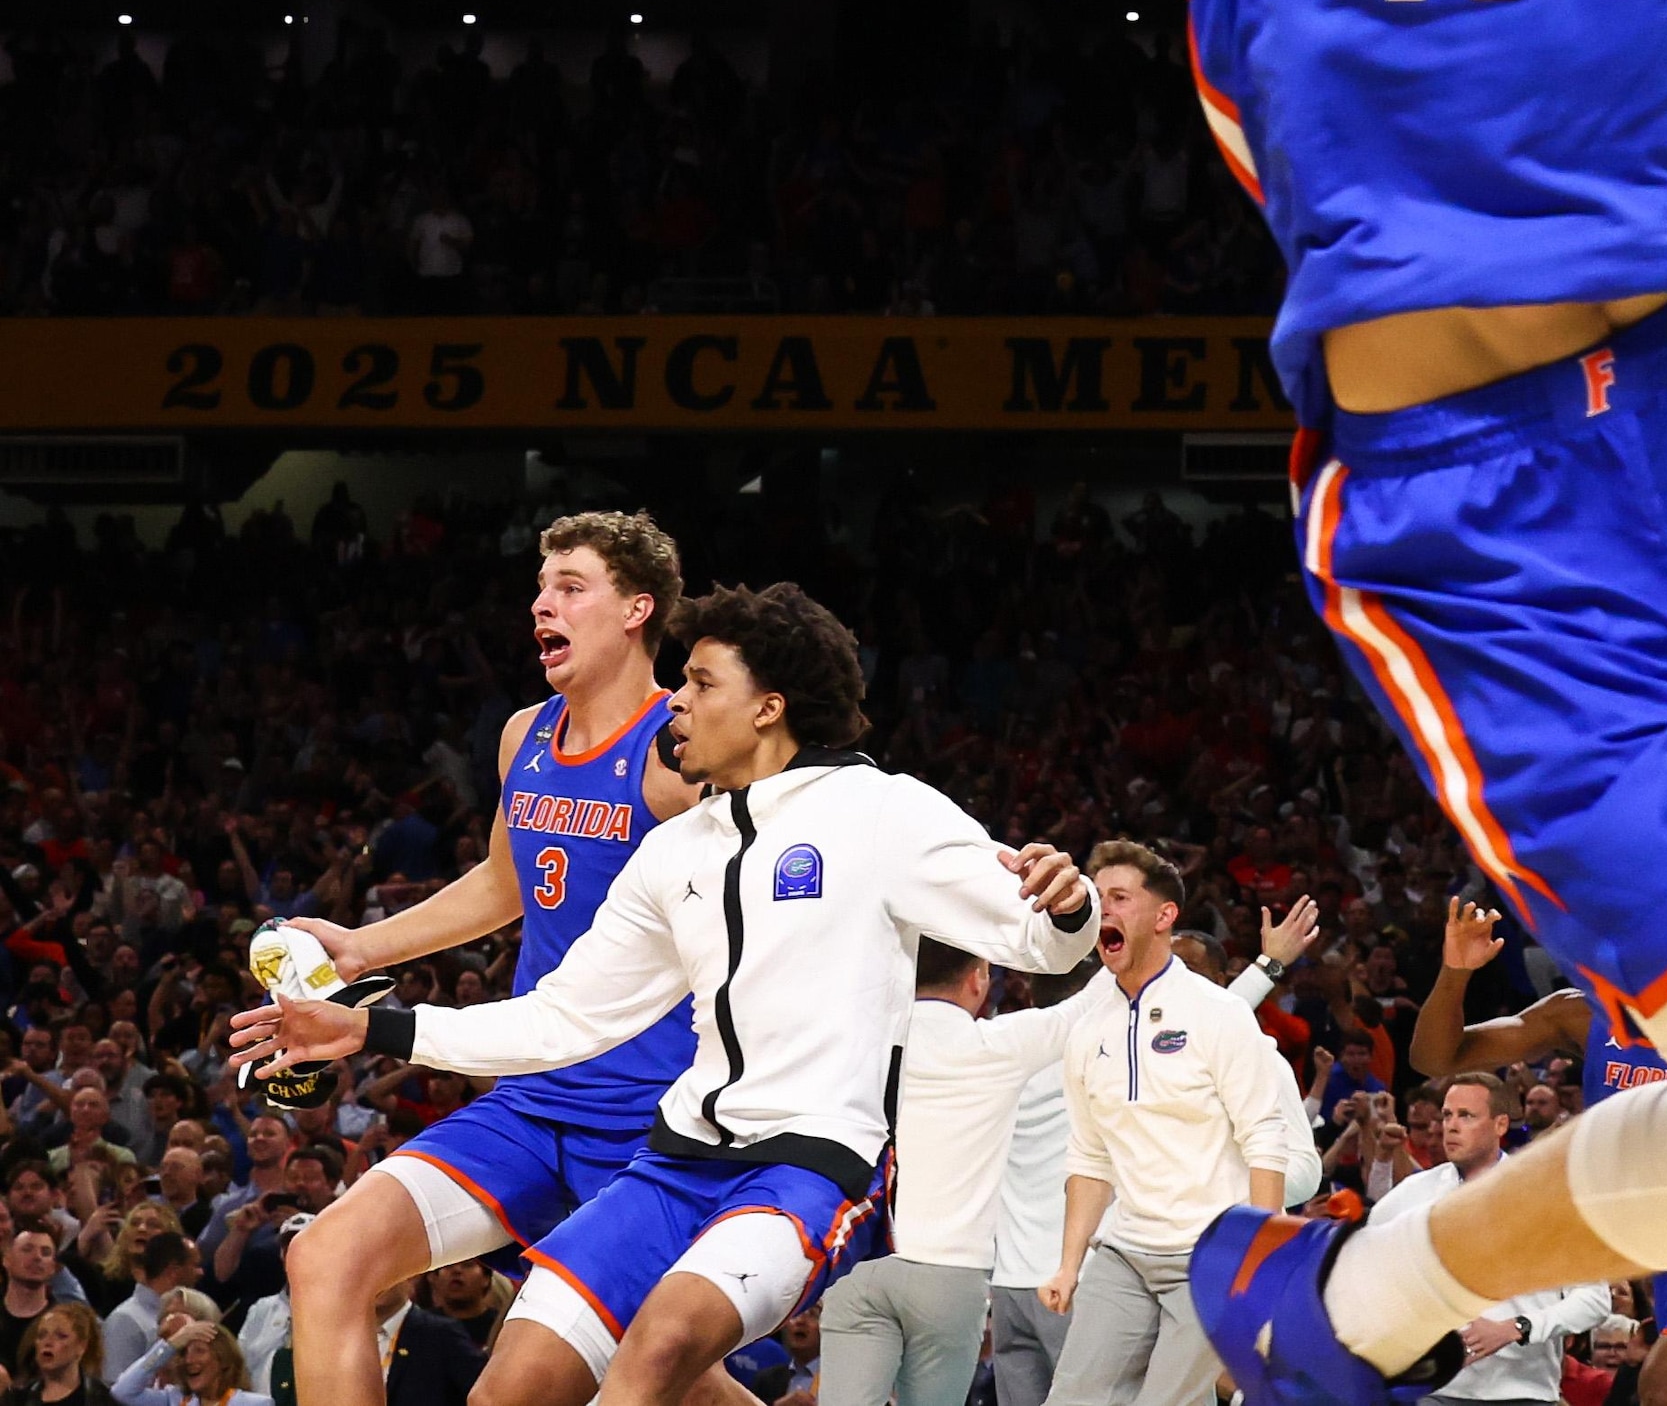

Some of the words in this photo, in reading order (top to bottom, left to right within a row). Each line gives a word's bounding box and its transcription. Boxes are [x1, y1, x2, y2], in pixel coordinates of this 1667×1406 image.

[161, 342, 485, 412] 2025
[555, 334, 937, 413] NCAA
[1579, 348, 1615, 418] F
[508, 791, 633, 842] FLORIDA
[533, 846, 570, 910] 3
